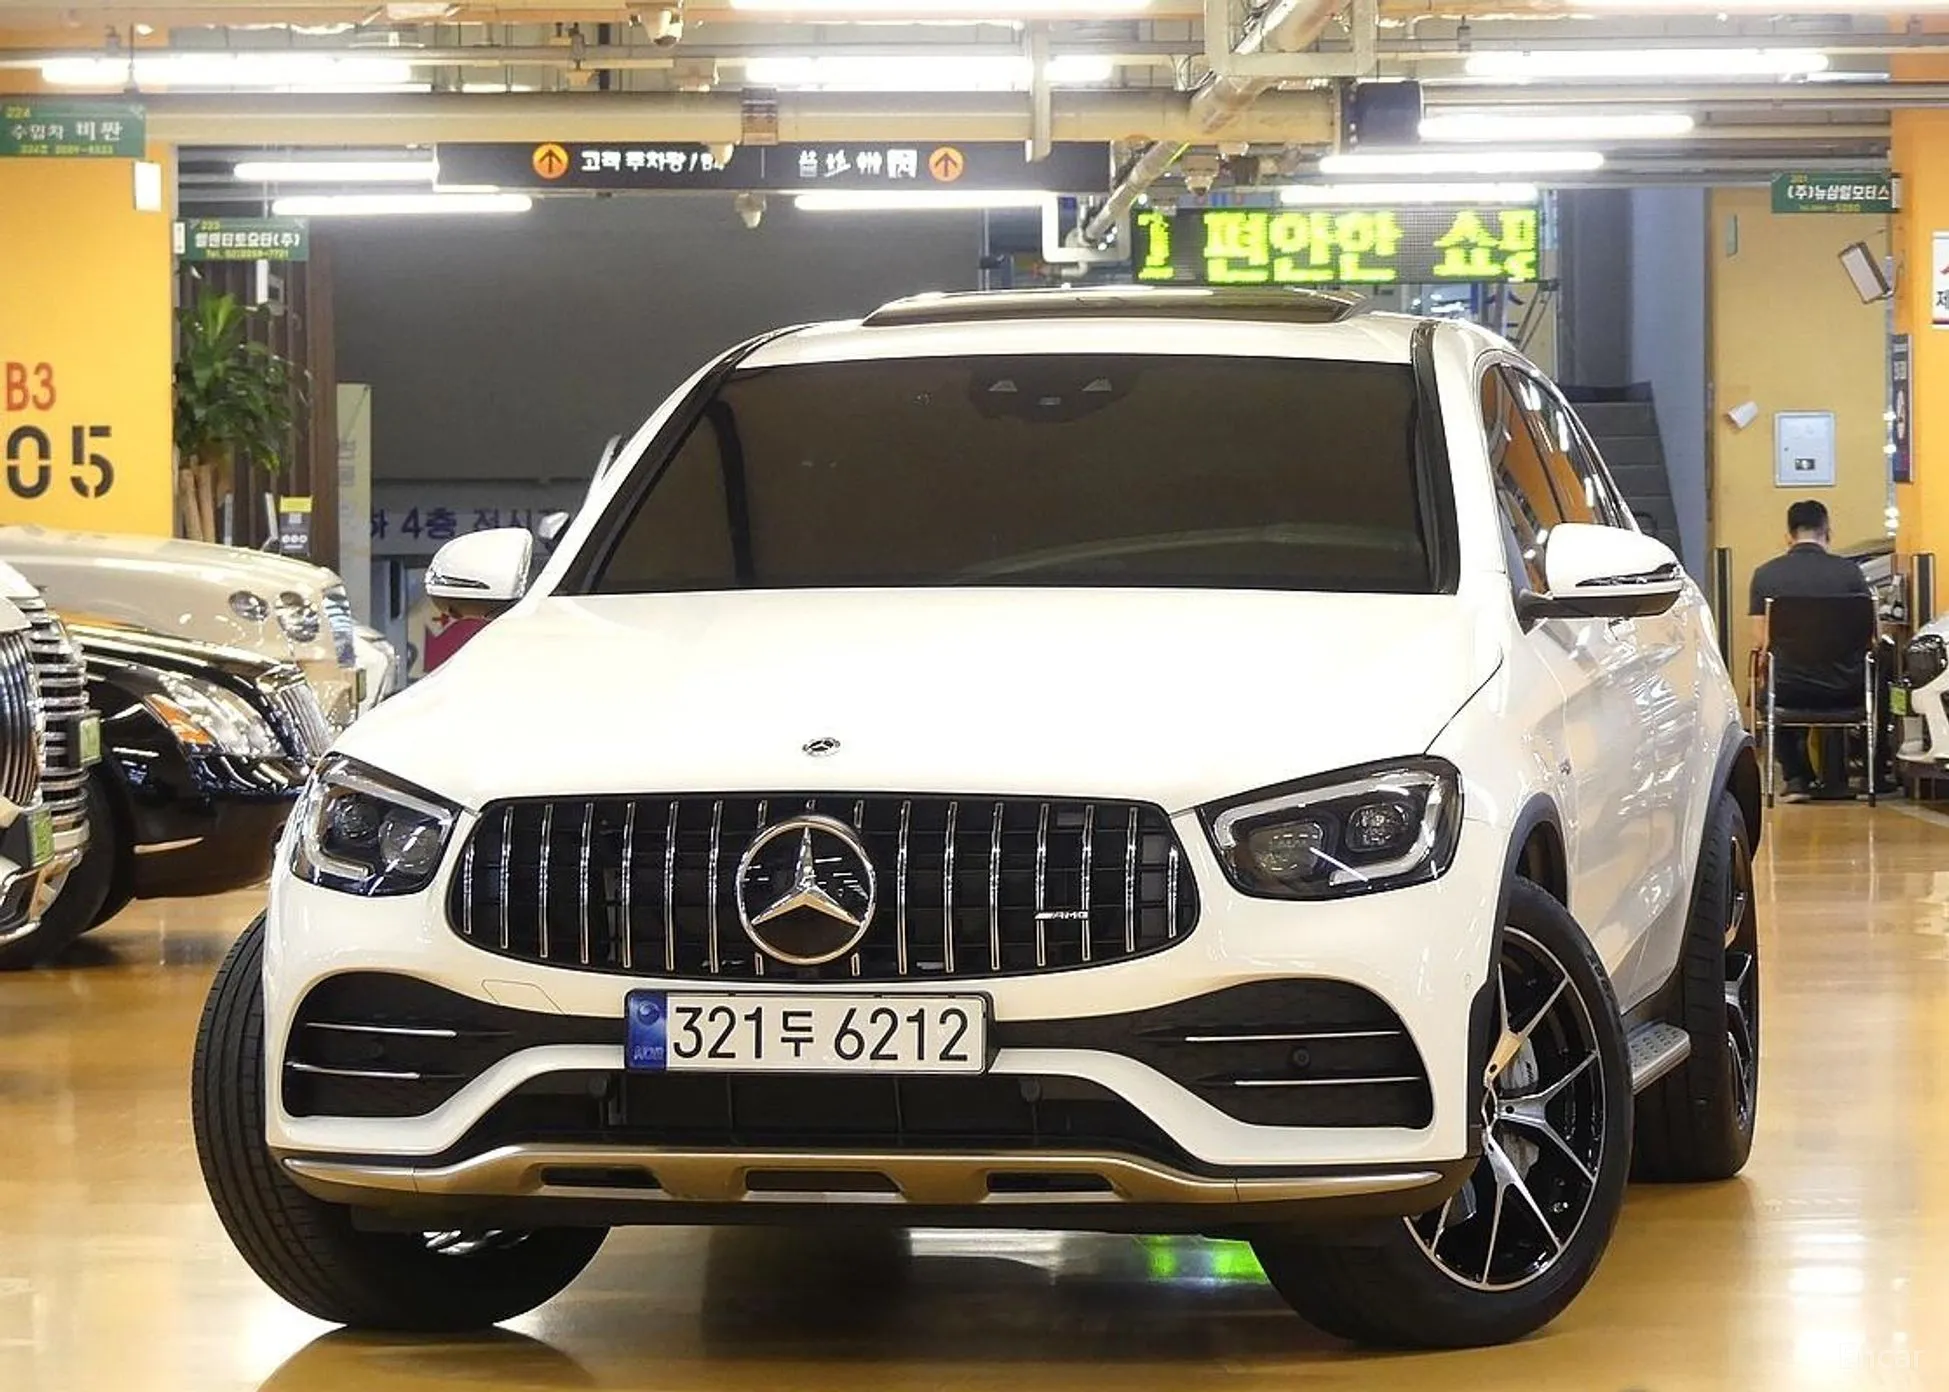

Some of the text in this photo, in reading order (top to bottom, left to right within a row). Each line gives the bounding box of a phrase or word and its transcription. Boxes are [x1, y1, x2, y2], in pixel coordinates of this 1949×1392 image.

[581, 151, 620, 171] 고객
[6, 362, 56, 411] B3
[7, 425, 114, 498] 05
[402, 507, 457, 541] 4층
[673, 1005, 968, 1062] 321두 6212
